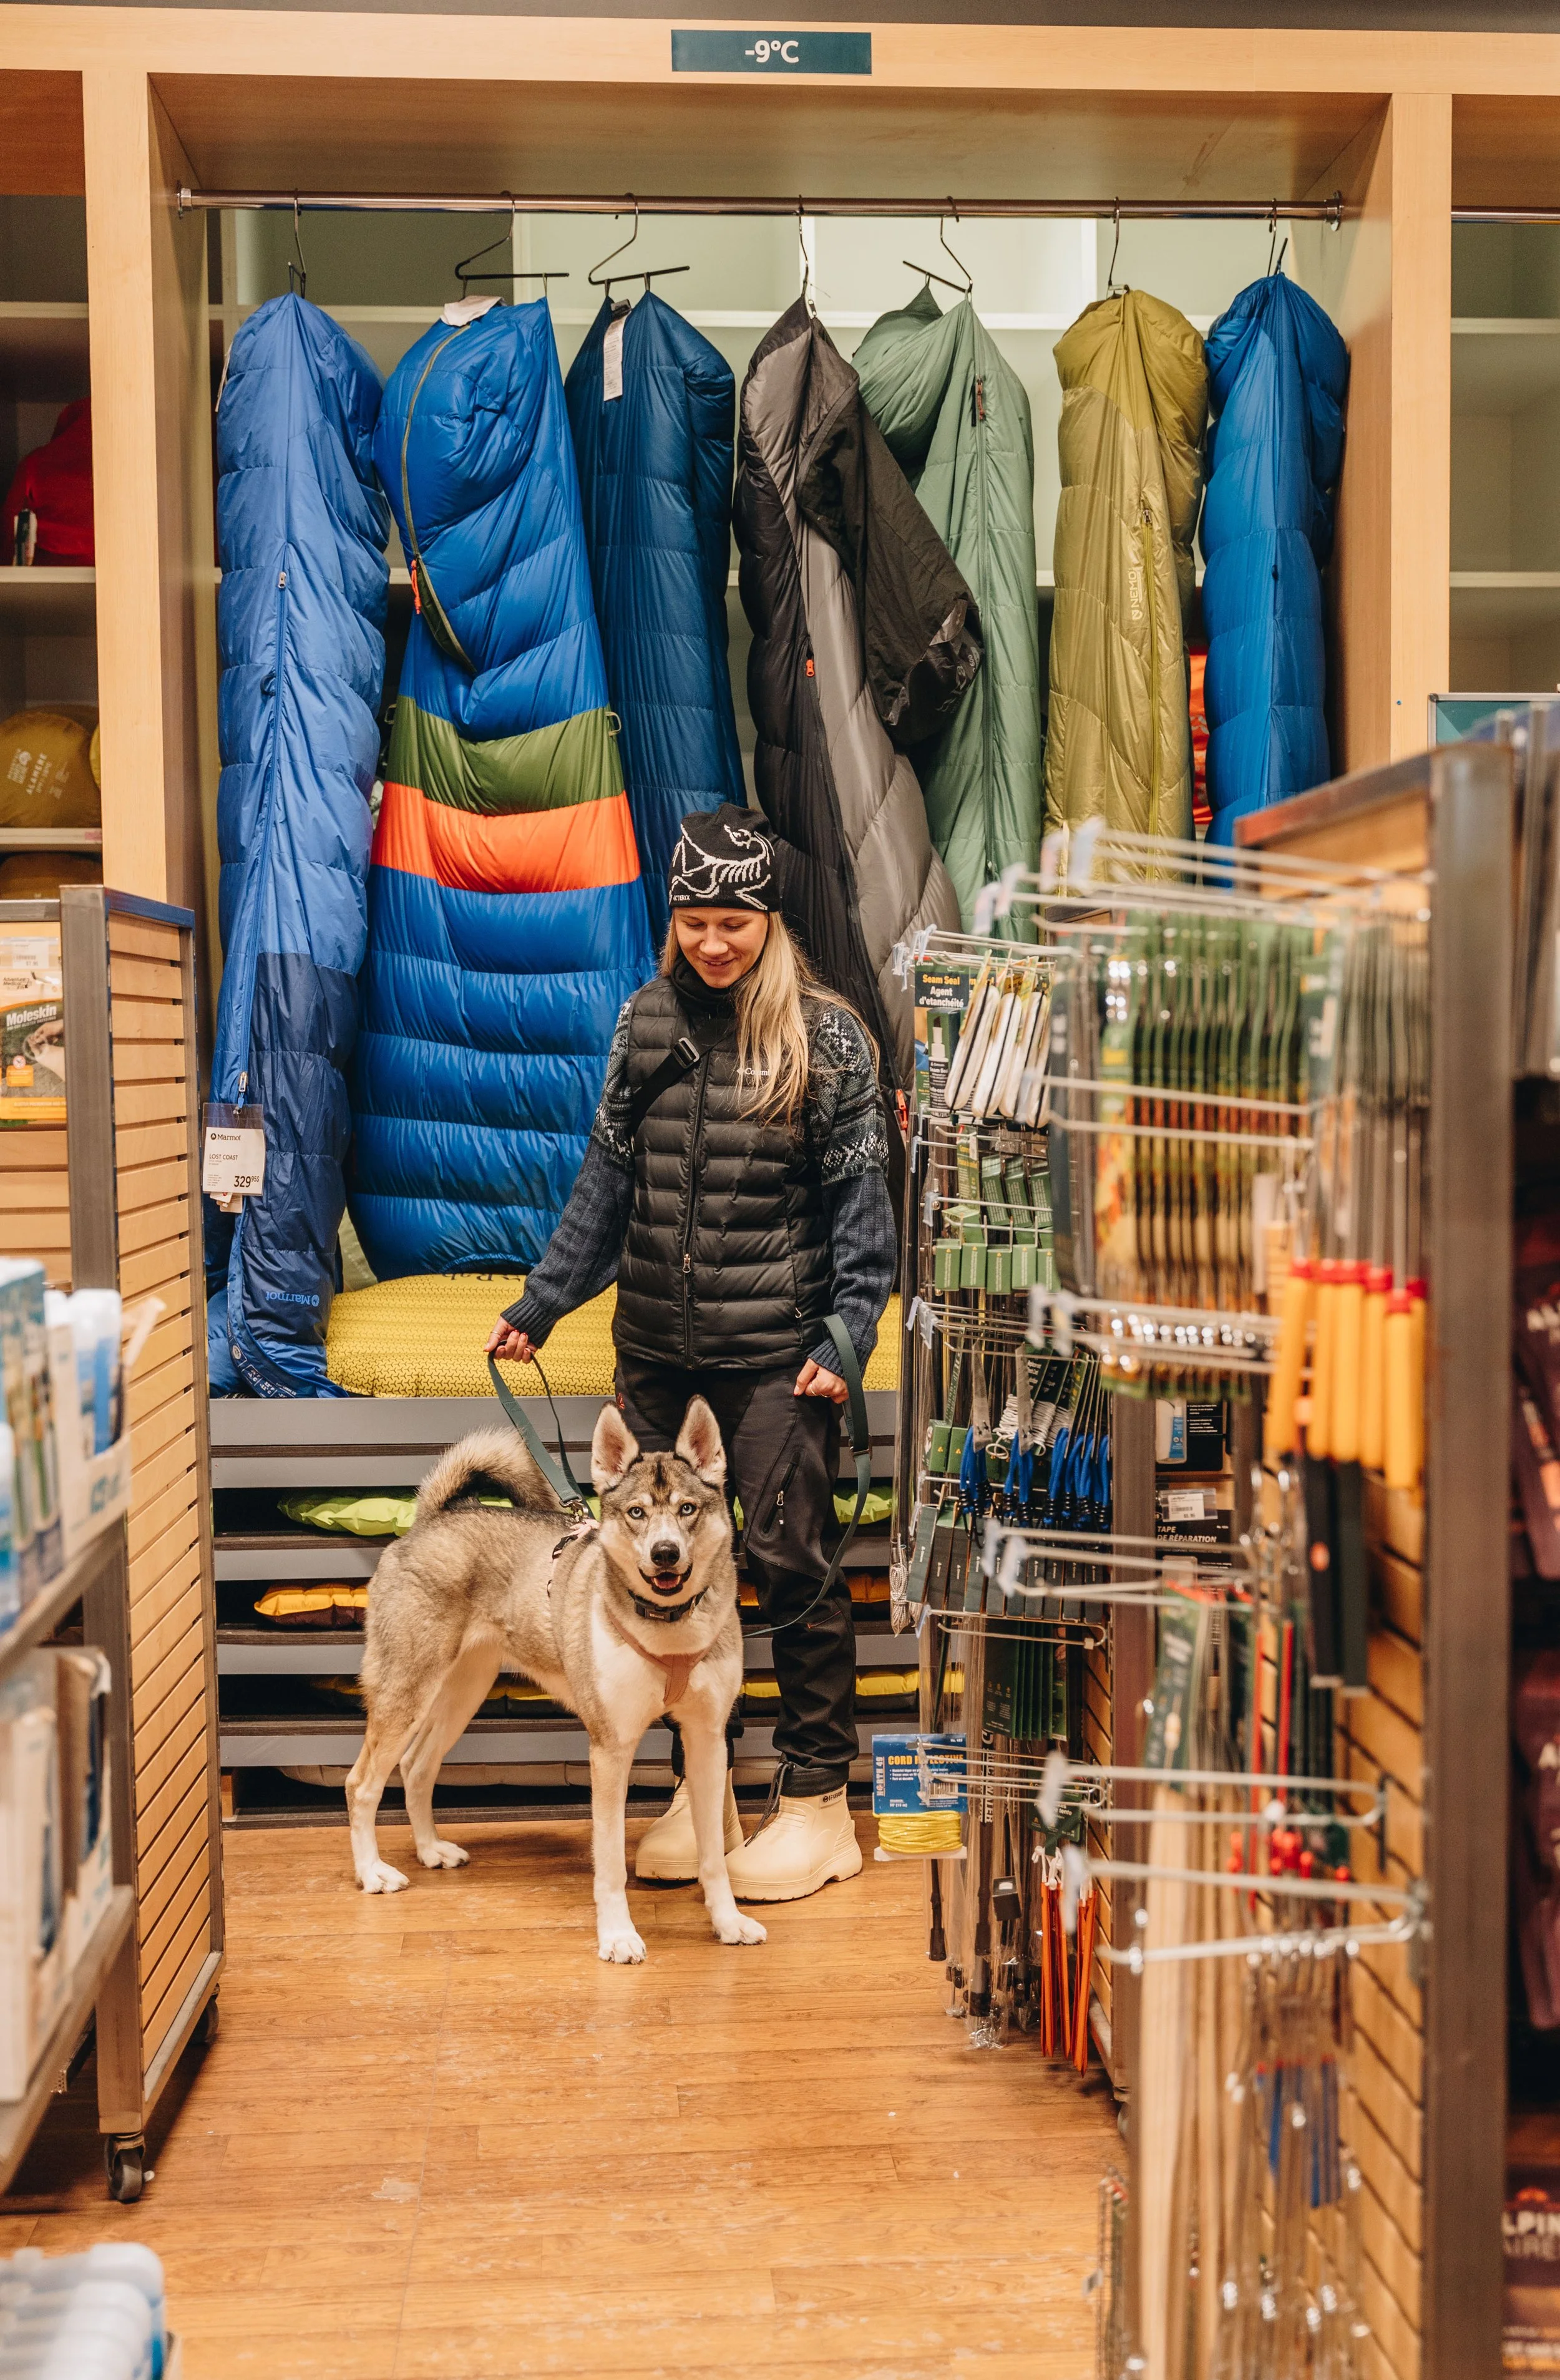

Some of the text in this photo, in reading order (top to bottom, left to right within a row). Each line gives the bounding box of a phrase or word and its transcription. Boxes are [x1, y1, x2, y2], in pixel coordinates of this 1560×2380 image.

[1128, 571, 1139, 608] NEMO
[922, 974, 943, 984] Seam
[944, 976, 960, 985] Seal
[930, 986, 953, 997] Agent
[6, 1005, 57, 1027] Moleskin
[265, 1291, 311, 1306] Marmot
[1169, 1534, 1217, 1543] RÉPARATION
[888, 1756, 913, 1765] CORD
